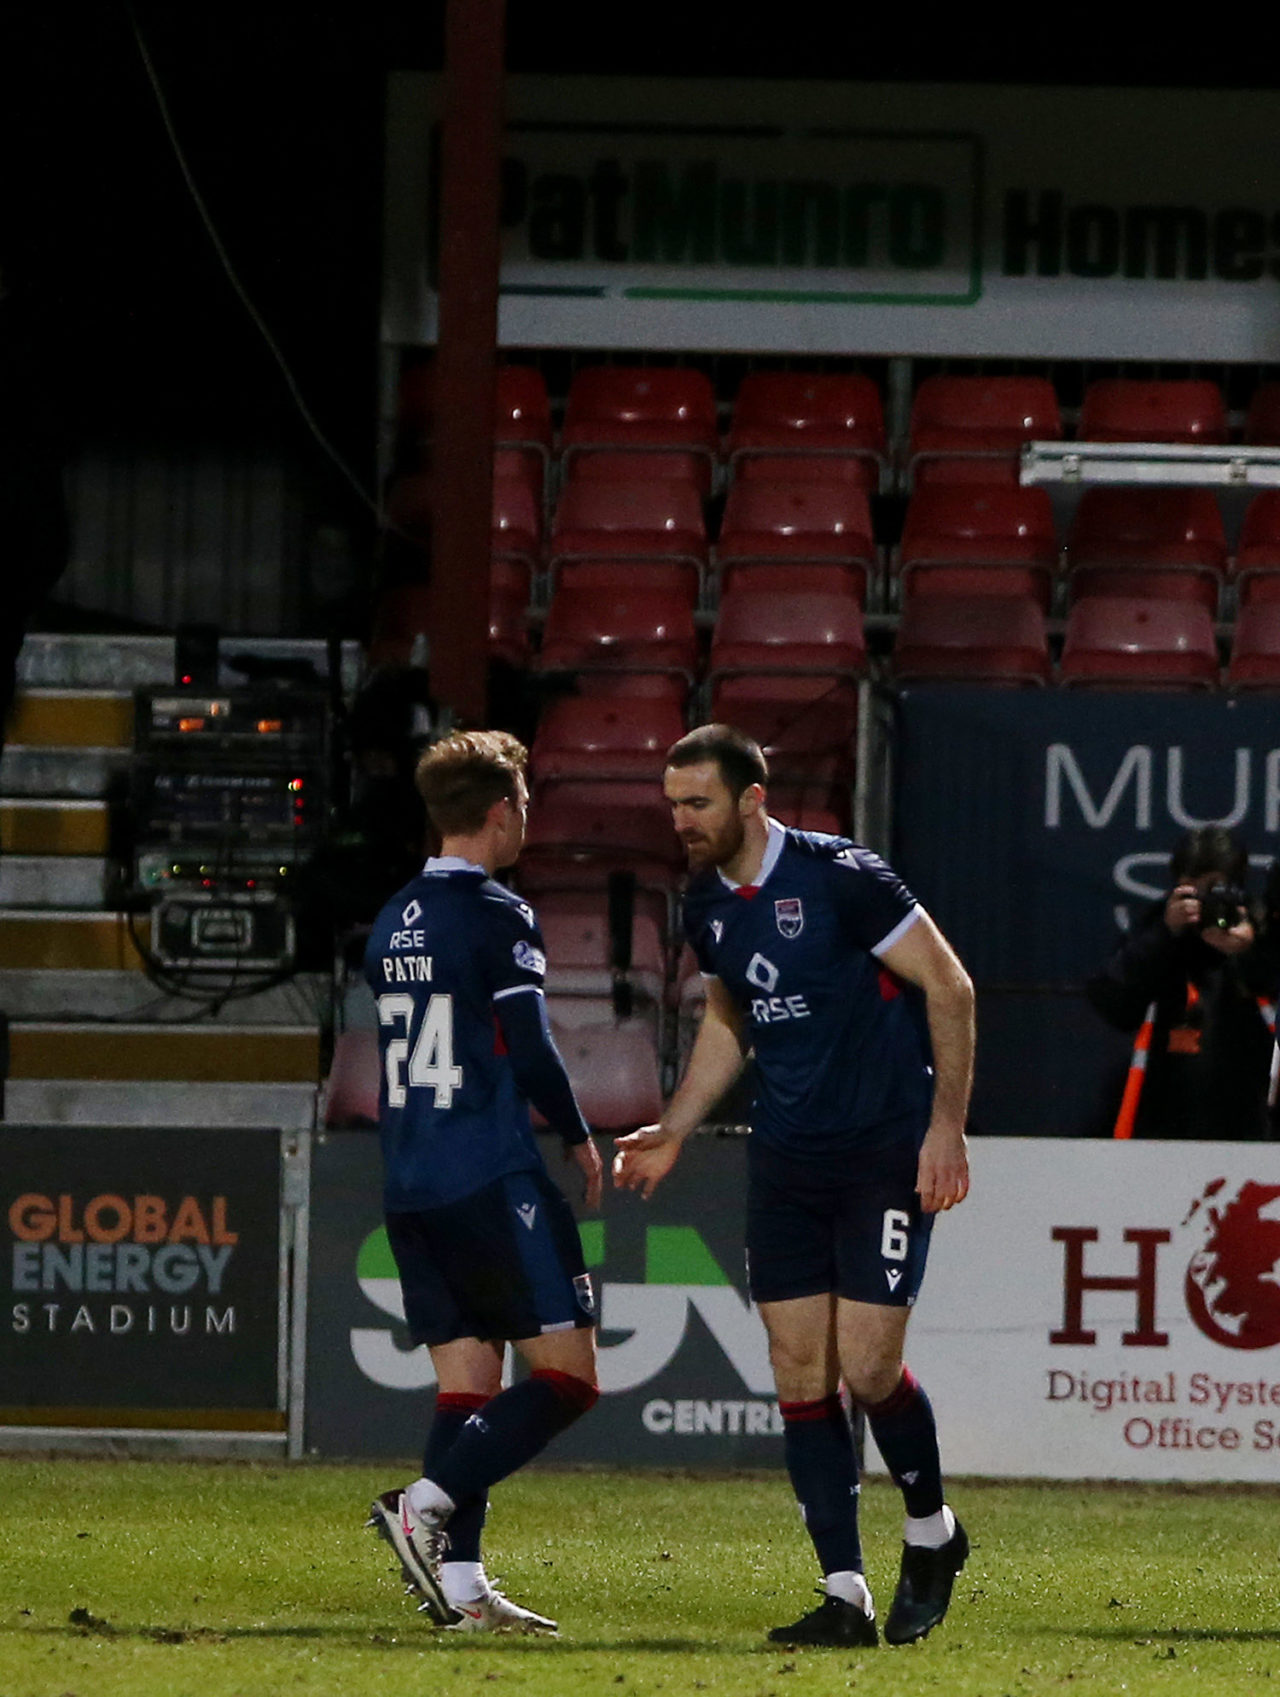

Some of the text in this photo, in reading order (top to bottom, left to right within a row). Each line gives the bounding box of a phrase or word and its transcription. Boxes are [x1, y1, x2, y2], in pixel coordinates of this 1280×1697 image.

[389, 929, 425, 950] RSE
[750, 994, 812, 1023] RSE
[376, 992, 464, 1109] 24
[8, 1192, 240, 1245] GLOBAL
[880, 1207, 911, 1262] 6
[12, 1242, 234, 1294] ENERGY
[12, 1302, 237, 1334] STADIUM
[1046, 1369, 1176, 1411] Digital
[1123, 1417, 1240, 1450] Office
